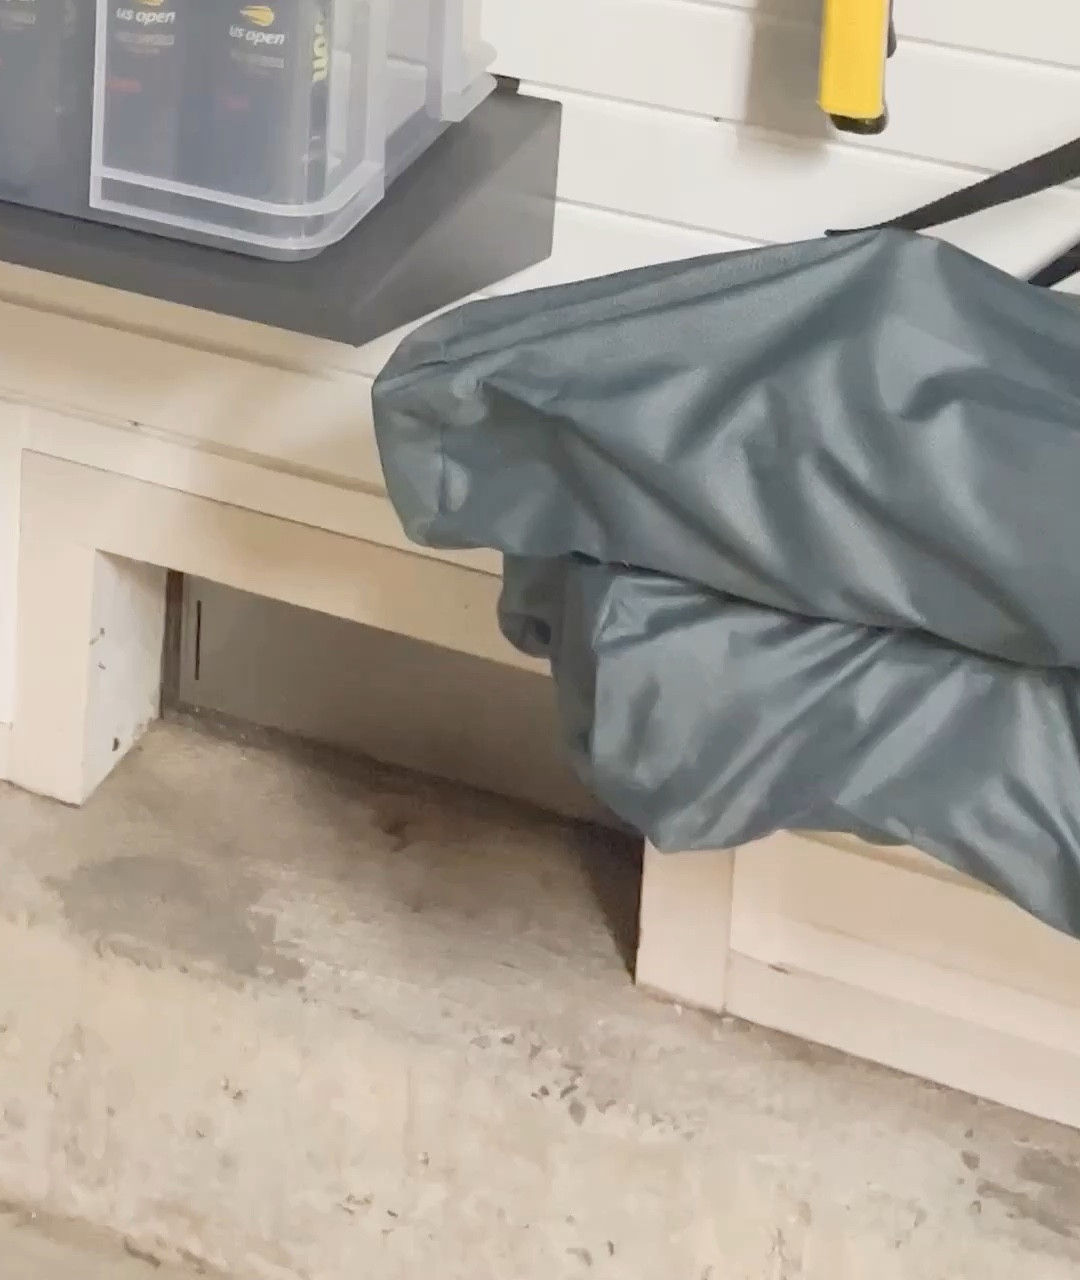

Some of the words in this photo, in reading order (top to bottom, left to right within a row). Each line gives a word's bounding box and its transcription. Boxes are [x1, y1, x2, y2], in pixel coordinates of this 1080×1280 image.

[115, 7, 134, 22] us
[135, 11, 177, 26] open
[228, 24, 245, 39] us
[245, 29, 286, 45] open
